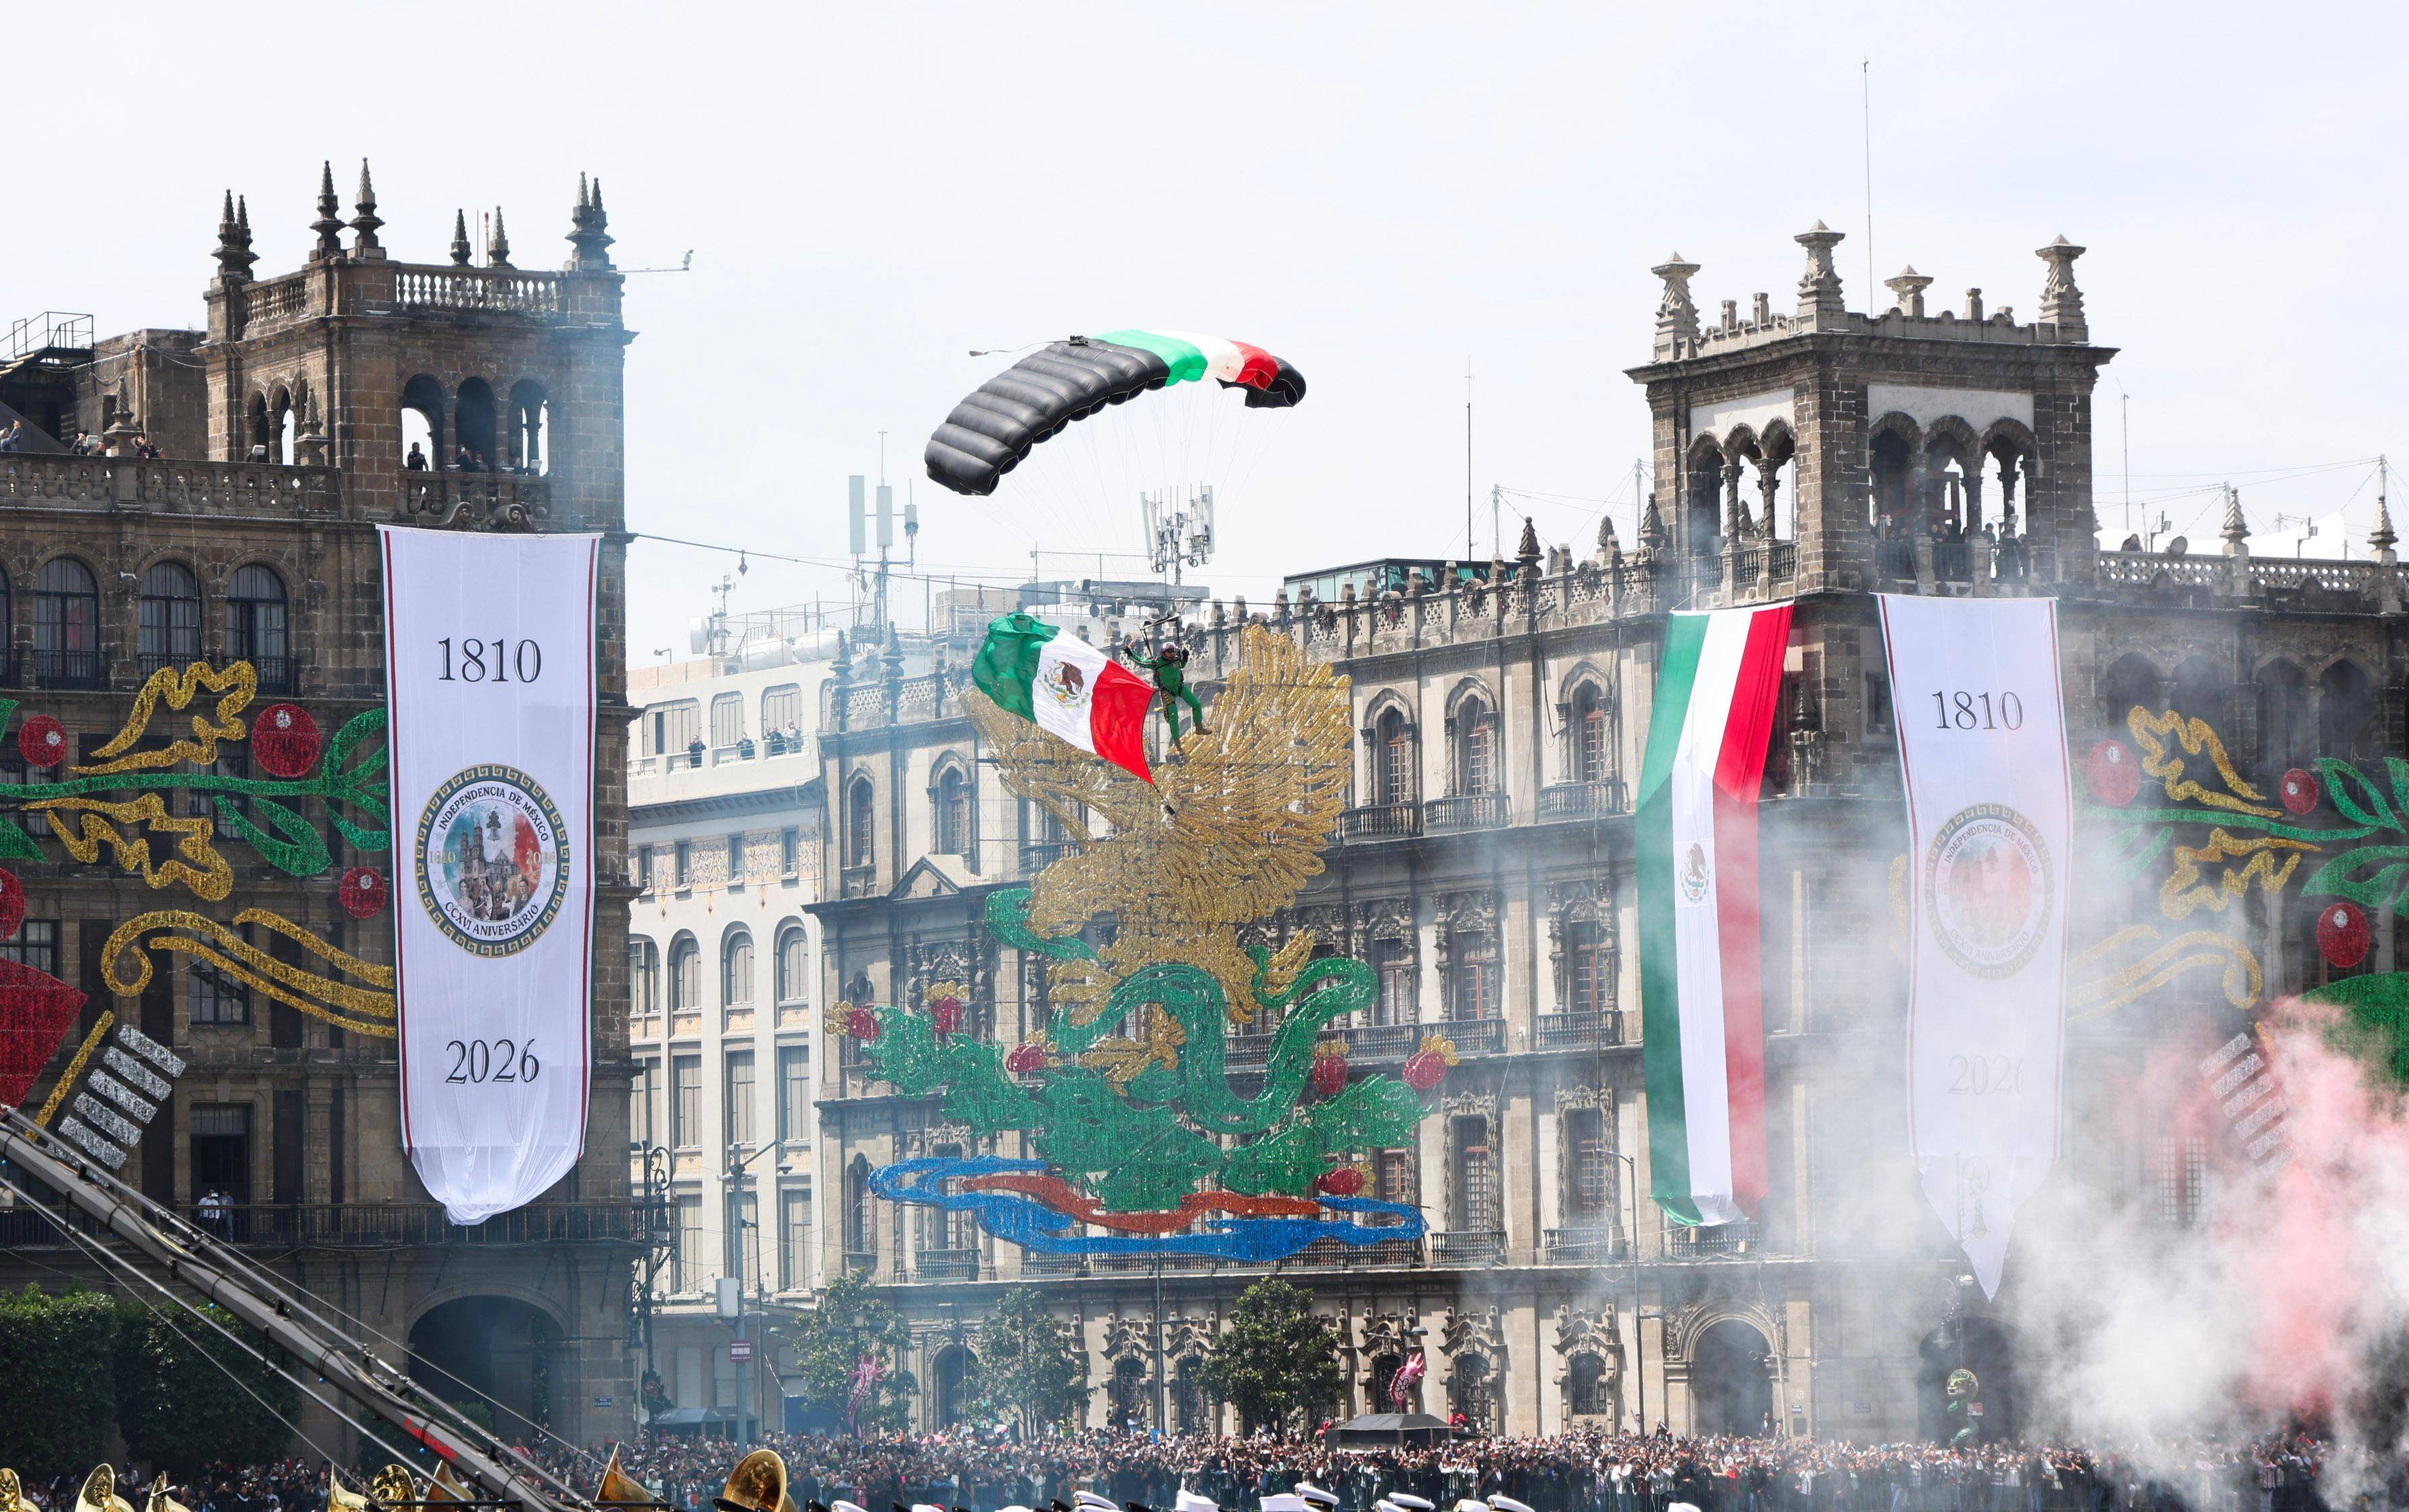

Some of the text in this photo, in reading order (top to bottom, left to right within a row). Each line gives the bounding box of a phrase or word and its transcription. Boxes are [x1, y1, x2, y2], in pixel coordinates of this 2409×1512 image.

[438, 637, 541, 683] 1810
[1932, 690, 2023, 730] 1810
[438, 786, 549, 842] INDEPENDENCIA DE MÉXICO
[1944, 824, 2002, 864] INDEPENDENCIA
[2004, 828, 2015, 841] DE
[445, 901, 540, 936] CCXVI ANIVERSARIO
[445, 1038, 539, 1084] 2026
